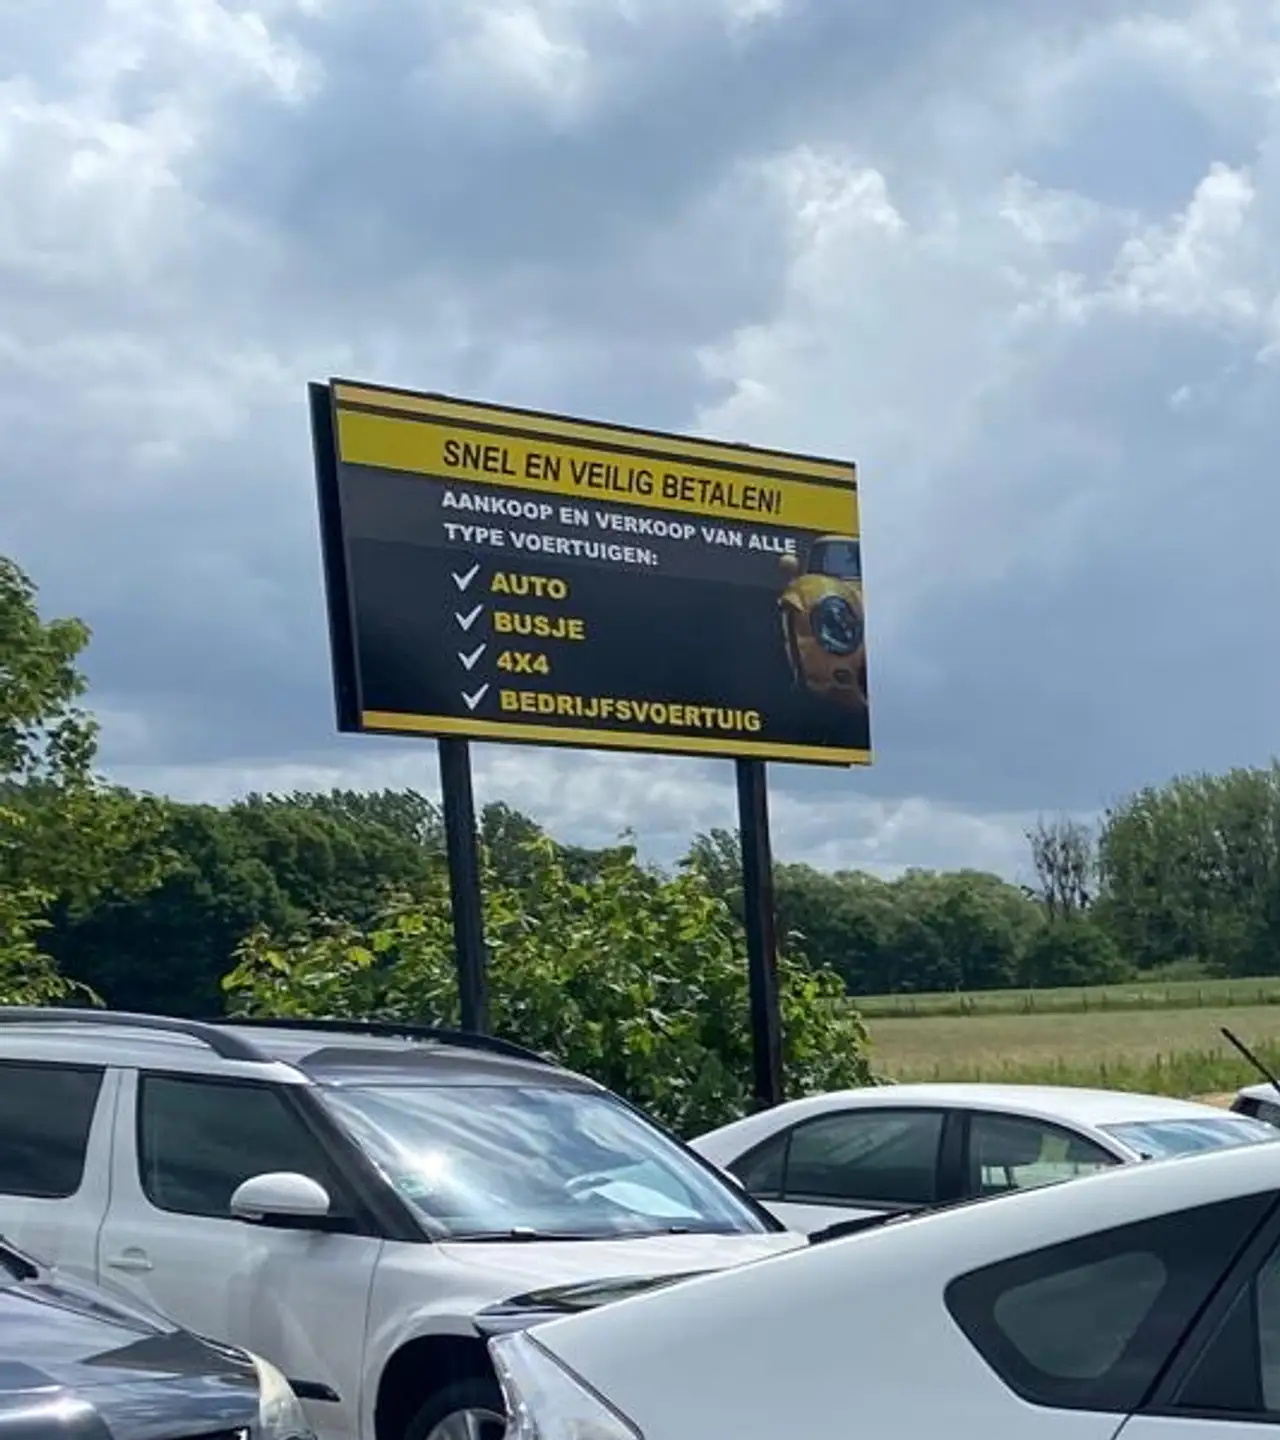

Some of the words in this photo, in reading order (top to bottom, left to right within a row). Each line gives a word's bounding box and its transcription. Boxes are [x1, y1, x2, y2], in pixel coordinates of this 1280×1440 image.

[443, 440, 516, 476] SNEL
[525, 453, 561, 481] EN
[570, 457, 654, 495] VEILIG
[662, 473, 782, 514] BETALEN!
[441, 491, 553, 520] AANKOOP
[559, 506, 589, 526] EN
[595, 511, 696, 539] VERKOOP
[702, 527, 743, 547] VAN
[749, 534, 797, 553] ALLE
[443, 523, 504, 546] TYPE
[509, 531, 659, 566] VOERTUIGEN:
[491, 572, 567, 599] AUTO
[493, 611, 586, 640] BUSJE
[497, 651, 550, 674] 4X4
[500, 690, 762, 731] BEDRIJFSVOERTUIG
